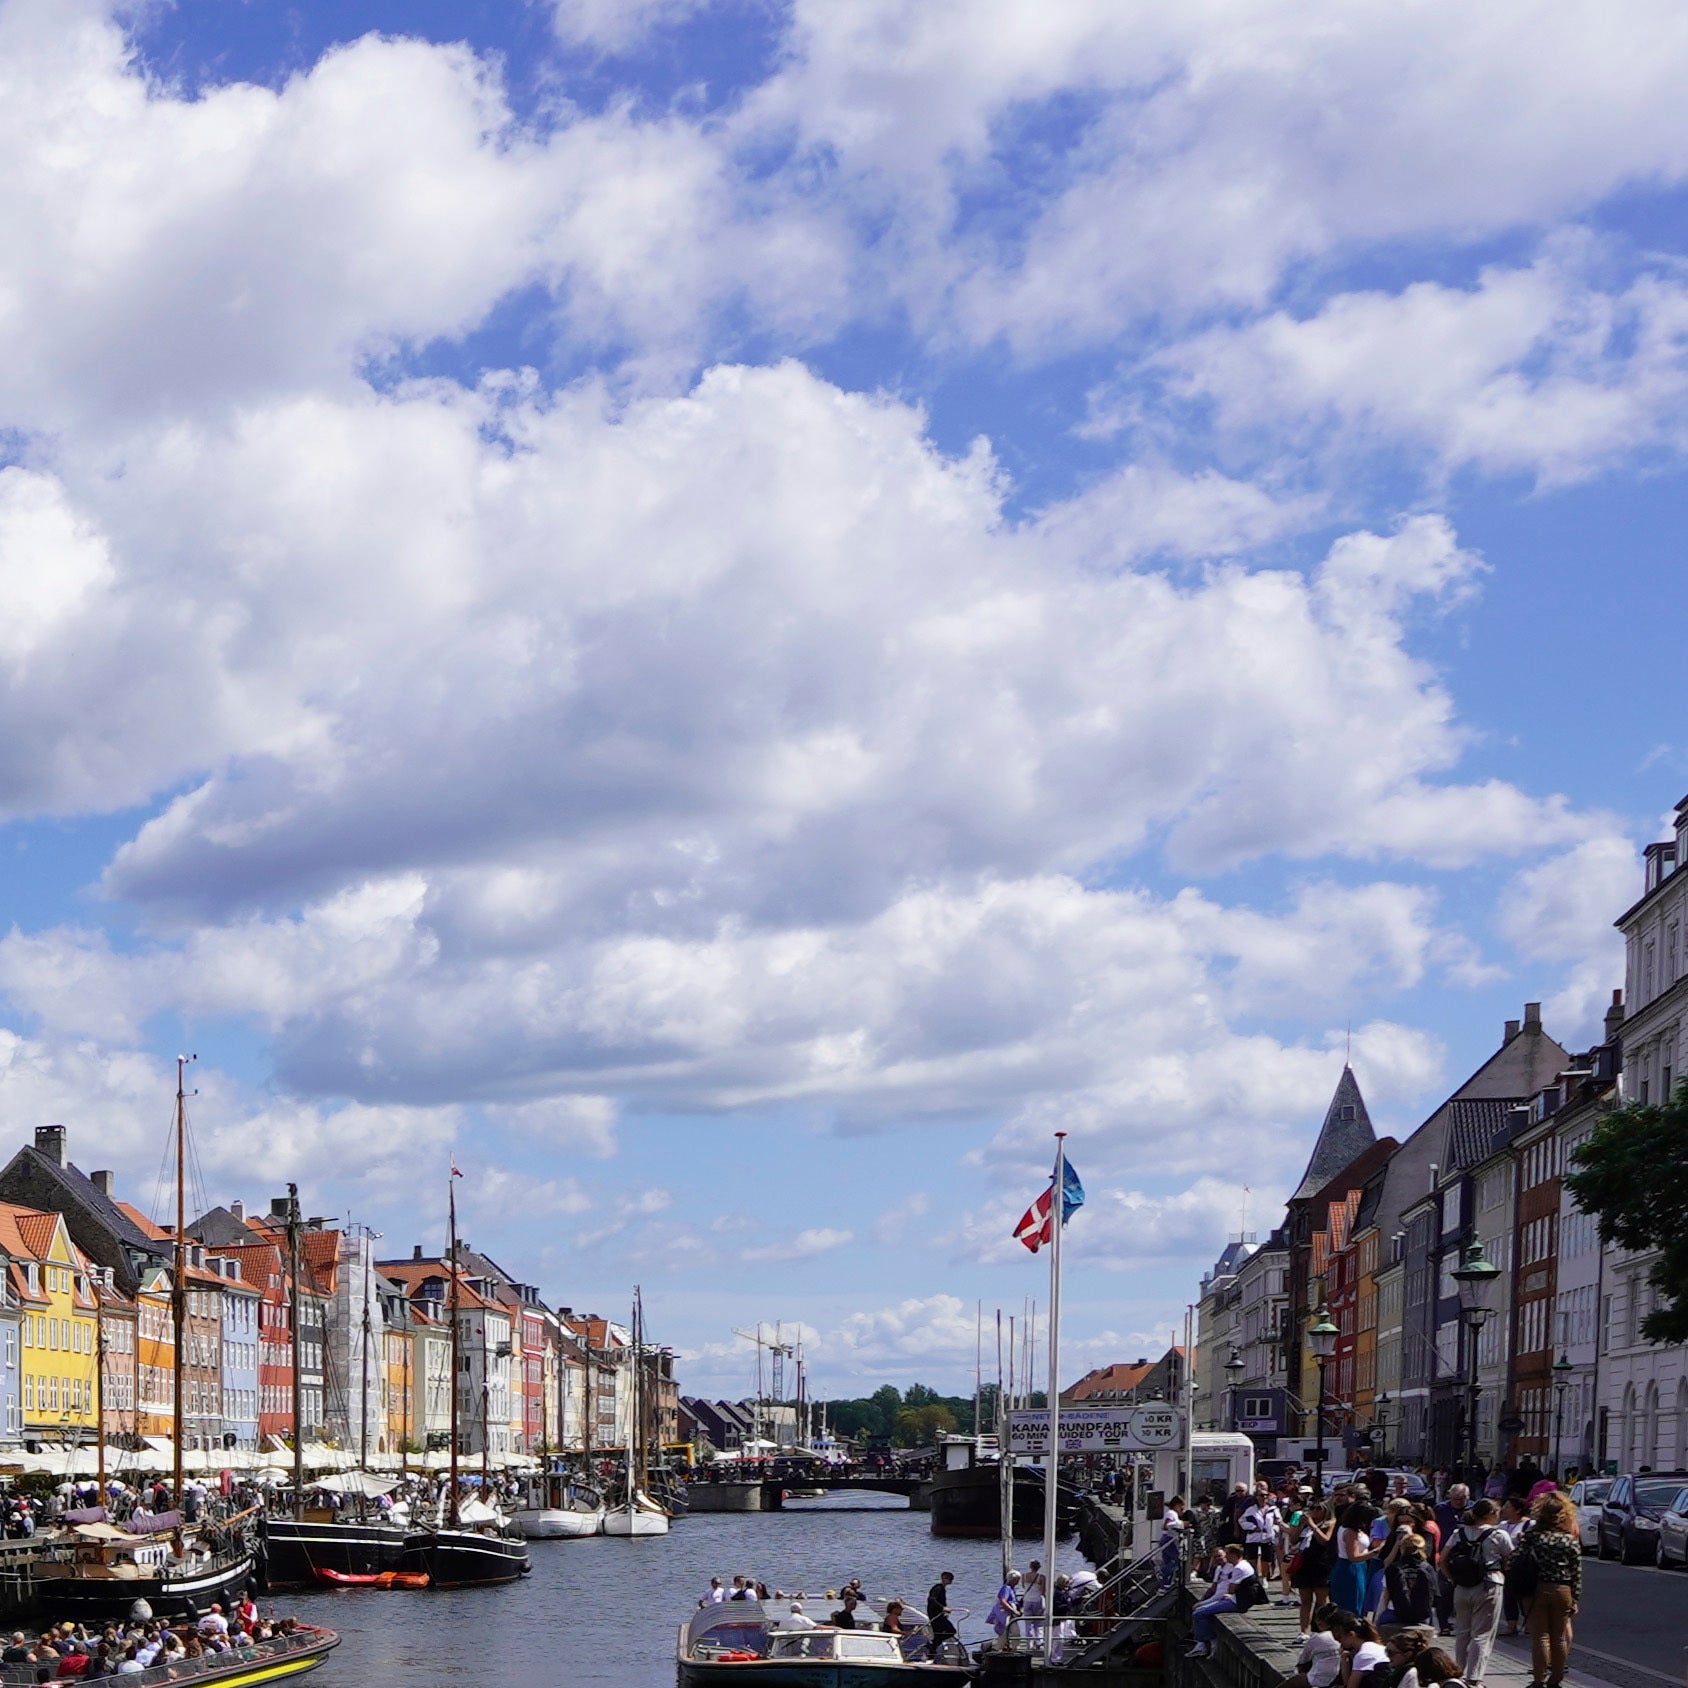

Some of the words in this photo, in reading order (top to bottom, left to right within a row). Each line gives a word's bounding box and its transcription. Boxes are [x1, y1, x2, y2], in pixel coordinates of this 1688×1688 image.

[1027, 1432, 1048, 1440] MIN
[1057, 1430, 1094, 1439] UIDED
[1099, 1430, 1129, 1438] TOUR
